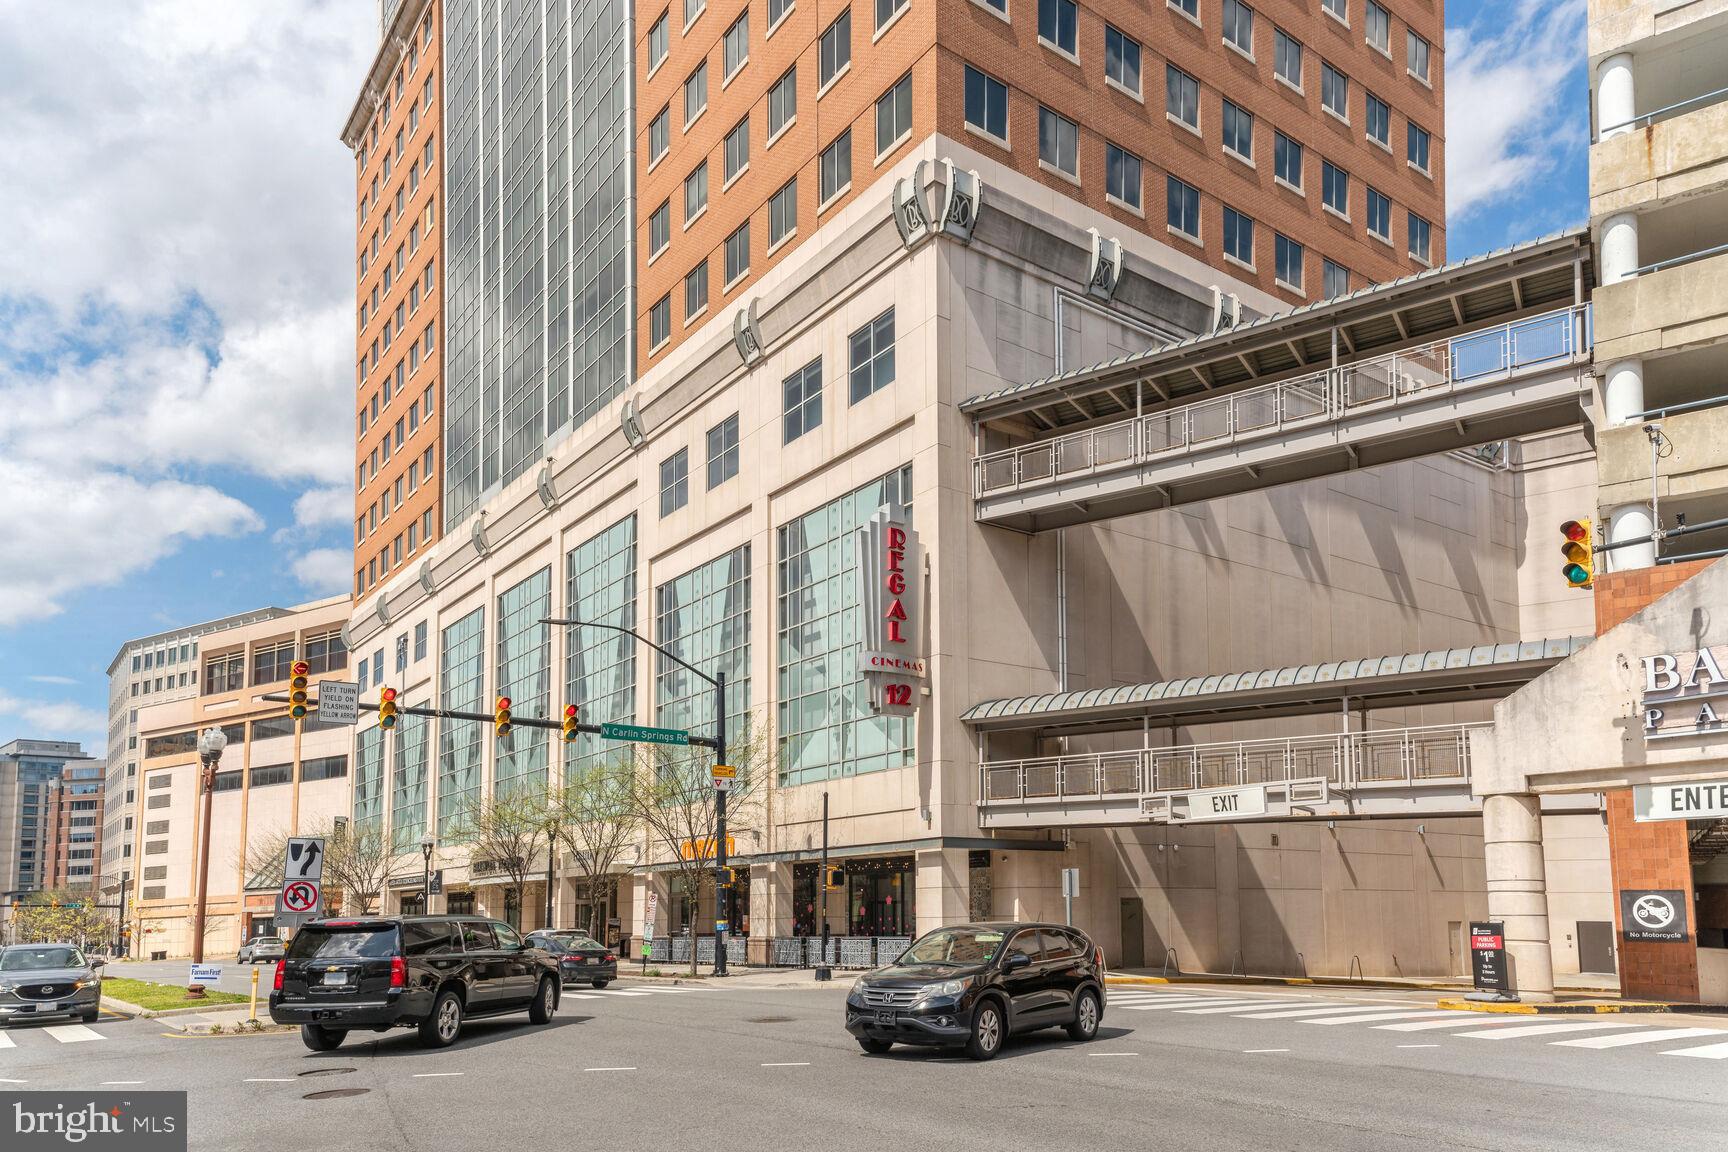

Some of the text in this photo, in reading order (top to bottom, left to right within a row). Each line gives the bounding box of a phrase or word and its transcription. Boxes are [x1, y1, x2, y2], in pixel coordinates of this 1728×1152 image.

[886, 527, 907, 643] REGAL
[871, 656, 923, 672] CINEMAS
[325, 694, 342, 702] YIELD
[886, 683, 912, 706] 12
[323, 703, 354, 711] FLASHING
[602, 727, 688, 743] N Carlin Springs Rd
[1212, 794, 1238, 812] EXIT
